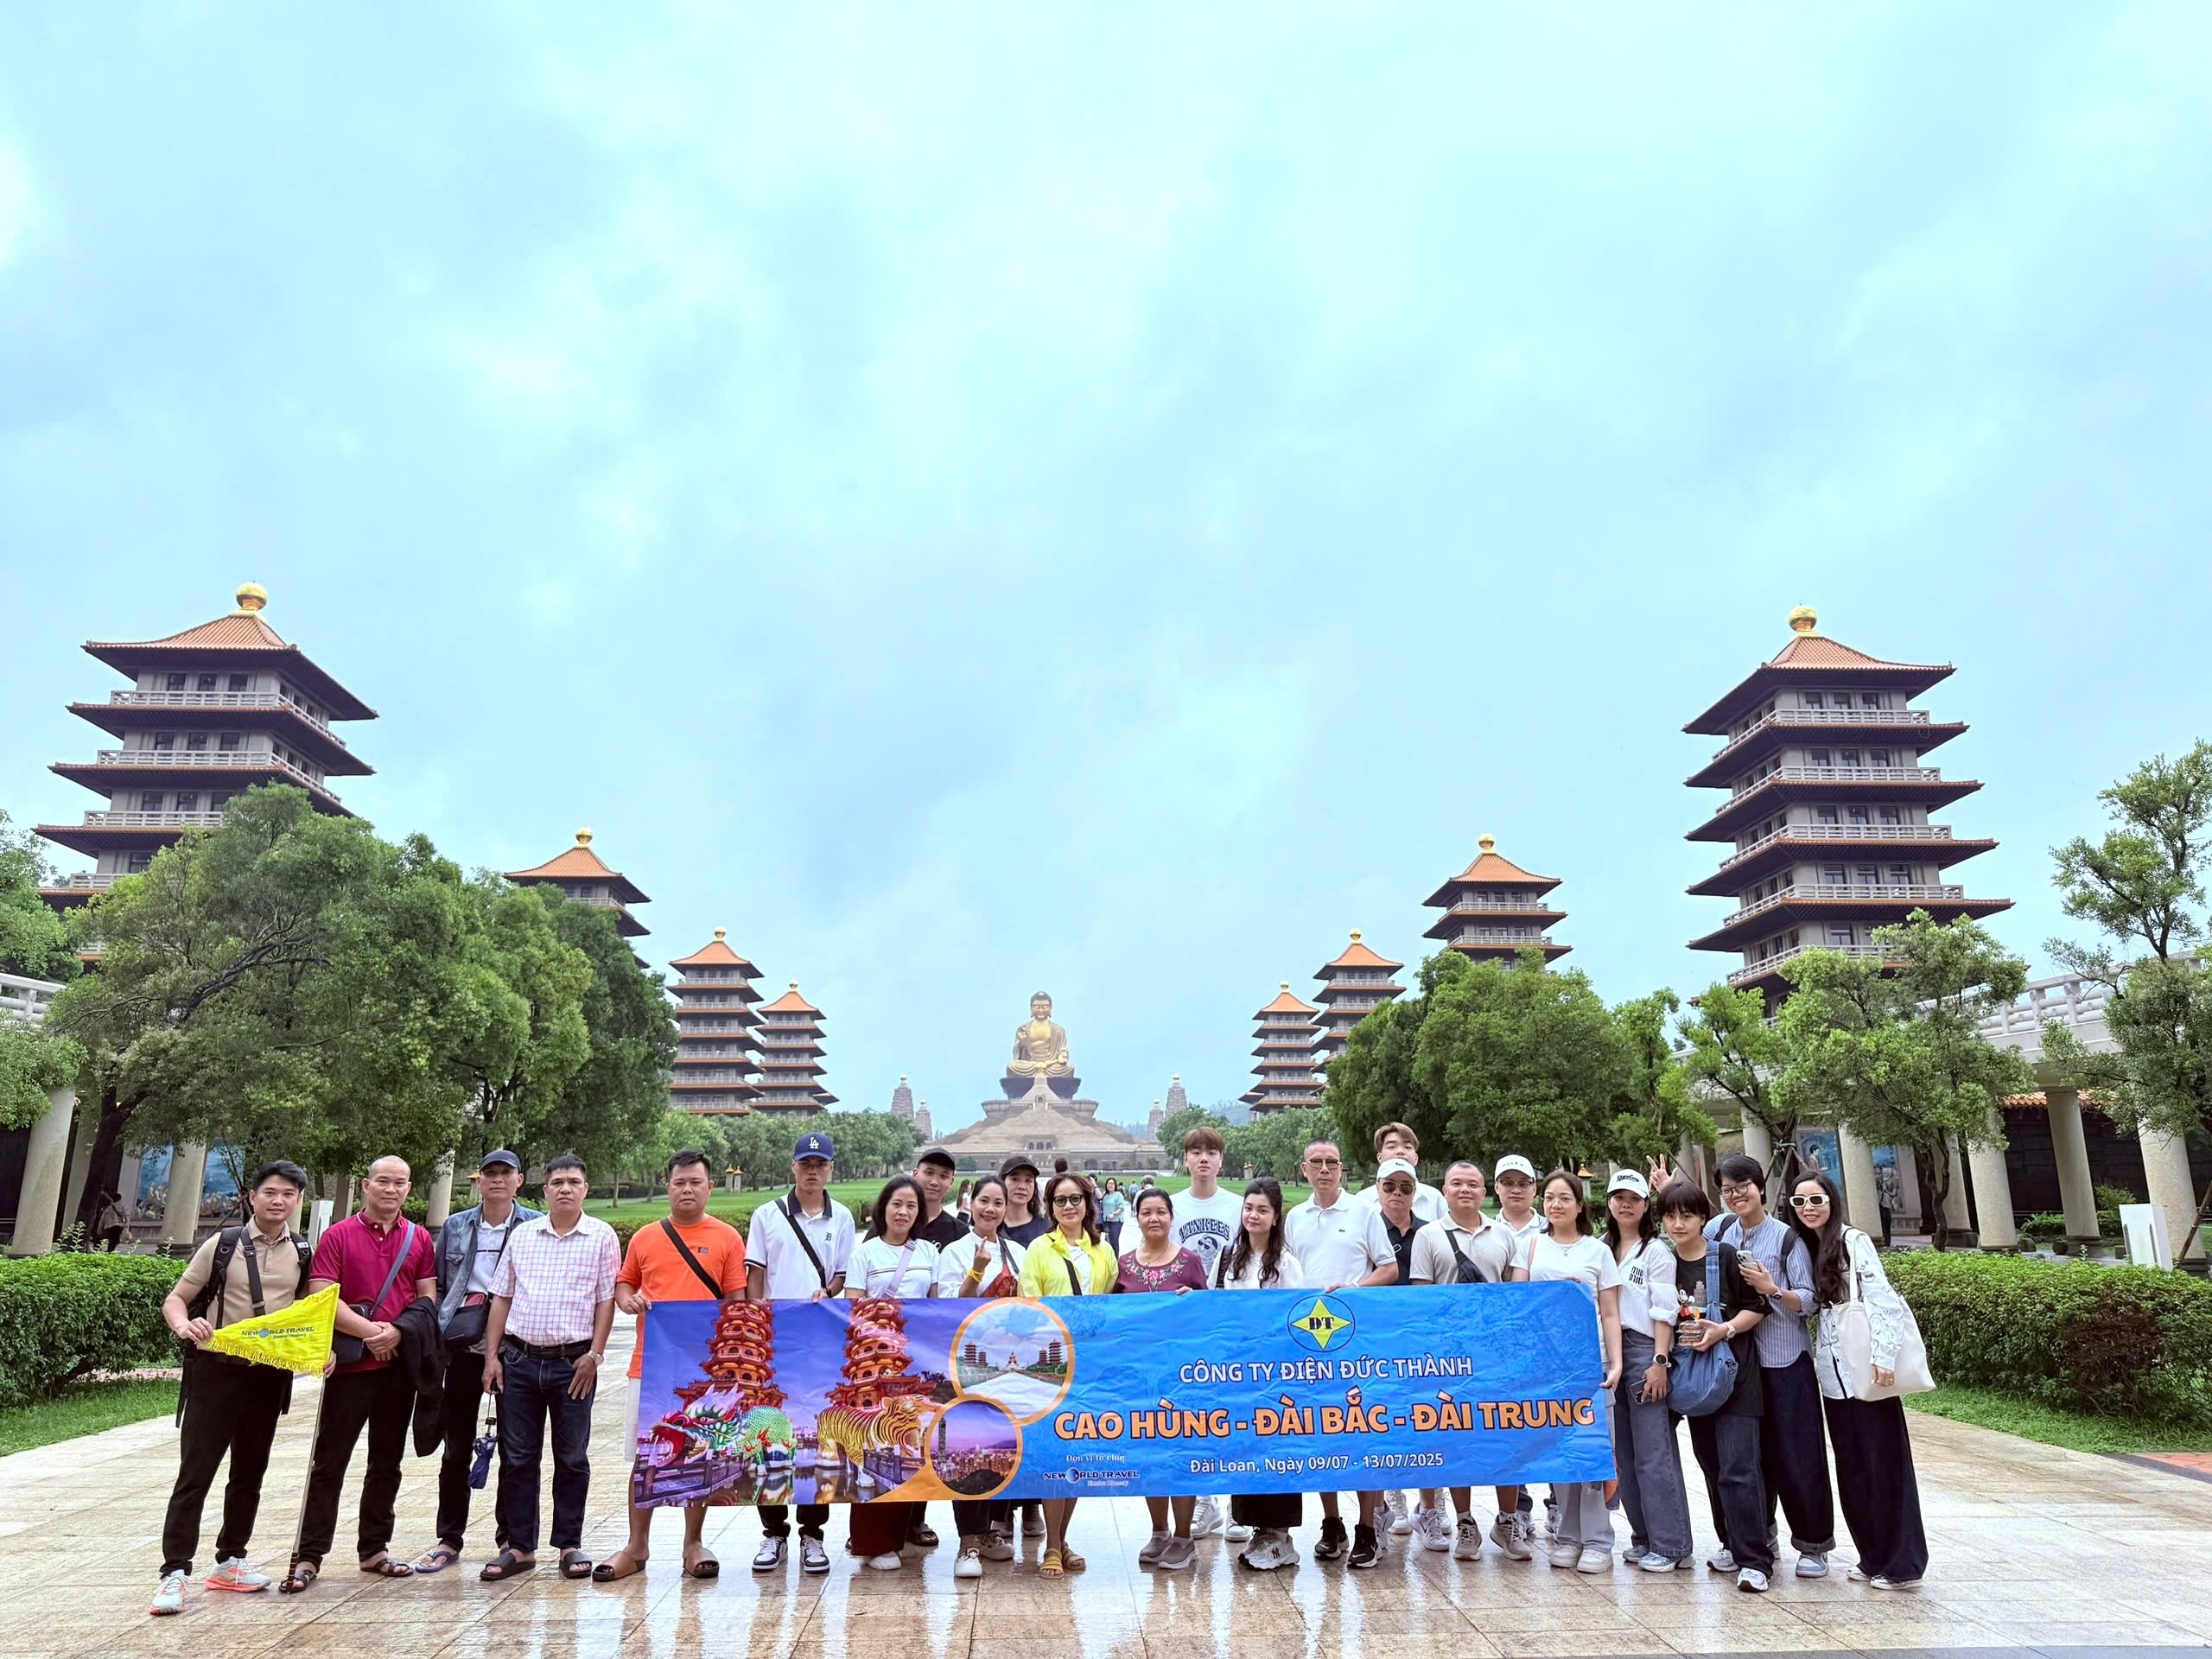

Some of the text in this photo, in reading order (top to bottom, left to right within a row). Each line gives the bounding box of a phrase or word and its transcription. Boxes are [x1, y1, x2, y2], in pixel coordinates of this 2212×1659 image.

[809, 1136, 819, 1149] LA
[1309, 1316, 1335, 1330] DT
[1179, 1352, 1473, 1385] CÔNG TY ĐIỆN ĐỨC THÀNH
[1054, 1410, 1124, 1440] CAO
[1130, 1396, 1230, 1439] HÙNG
[1253, 1394, 1314, 1436] ĐÀI
[1320, 1385, 1389, 1434] BẮC
[1411, 1389, 1473, 1431] ĐÀI
[1478, 1397, 1595, 1430] TRUNG
[1189, 1459, 1215, 1473] Đài
[1218, 1459, 1261, 1474] Loan,
[1264, 1458, 1305, 1474] Ngày
[1308, 1456, 1349, 1470] 09/07
[1362, 1452, 1444, 1468] 13/07/2025
[1099, 1470, 1140, 1478] TRAVEL
